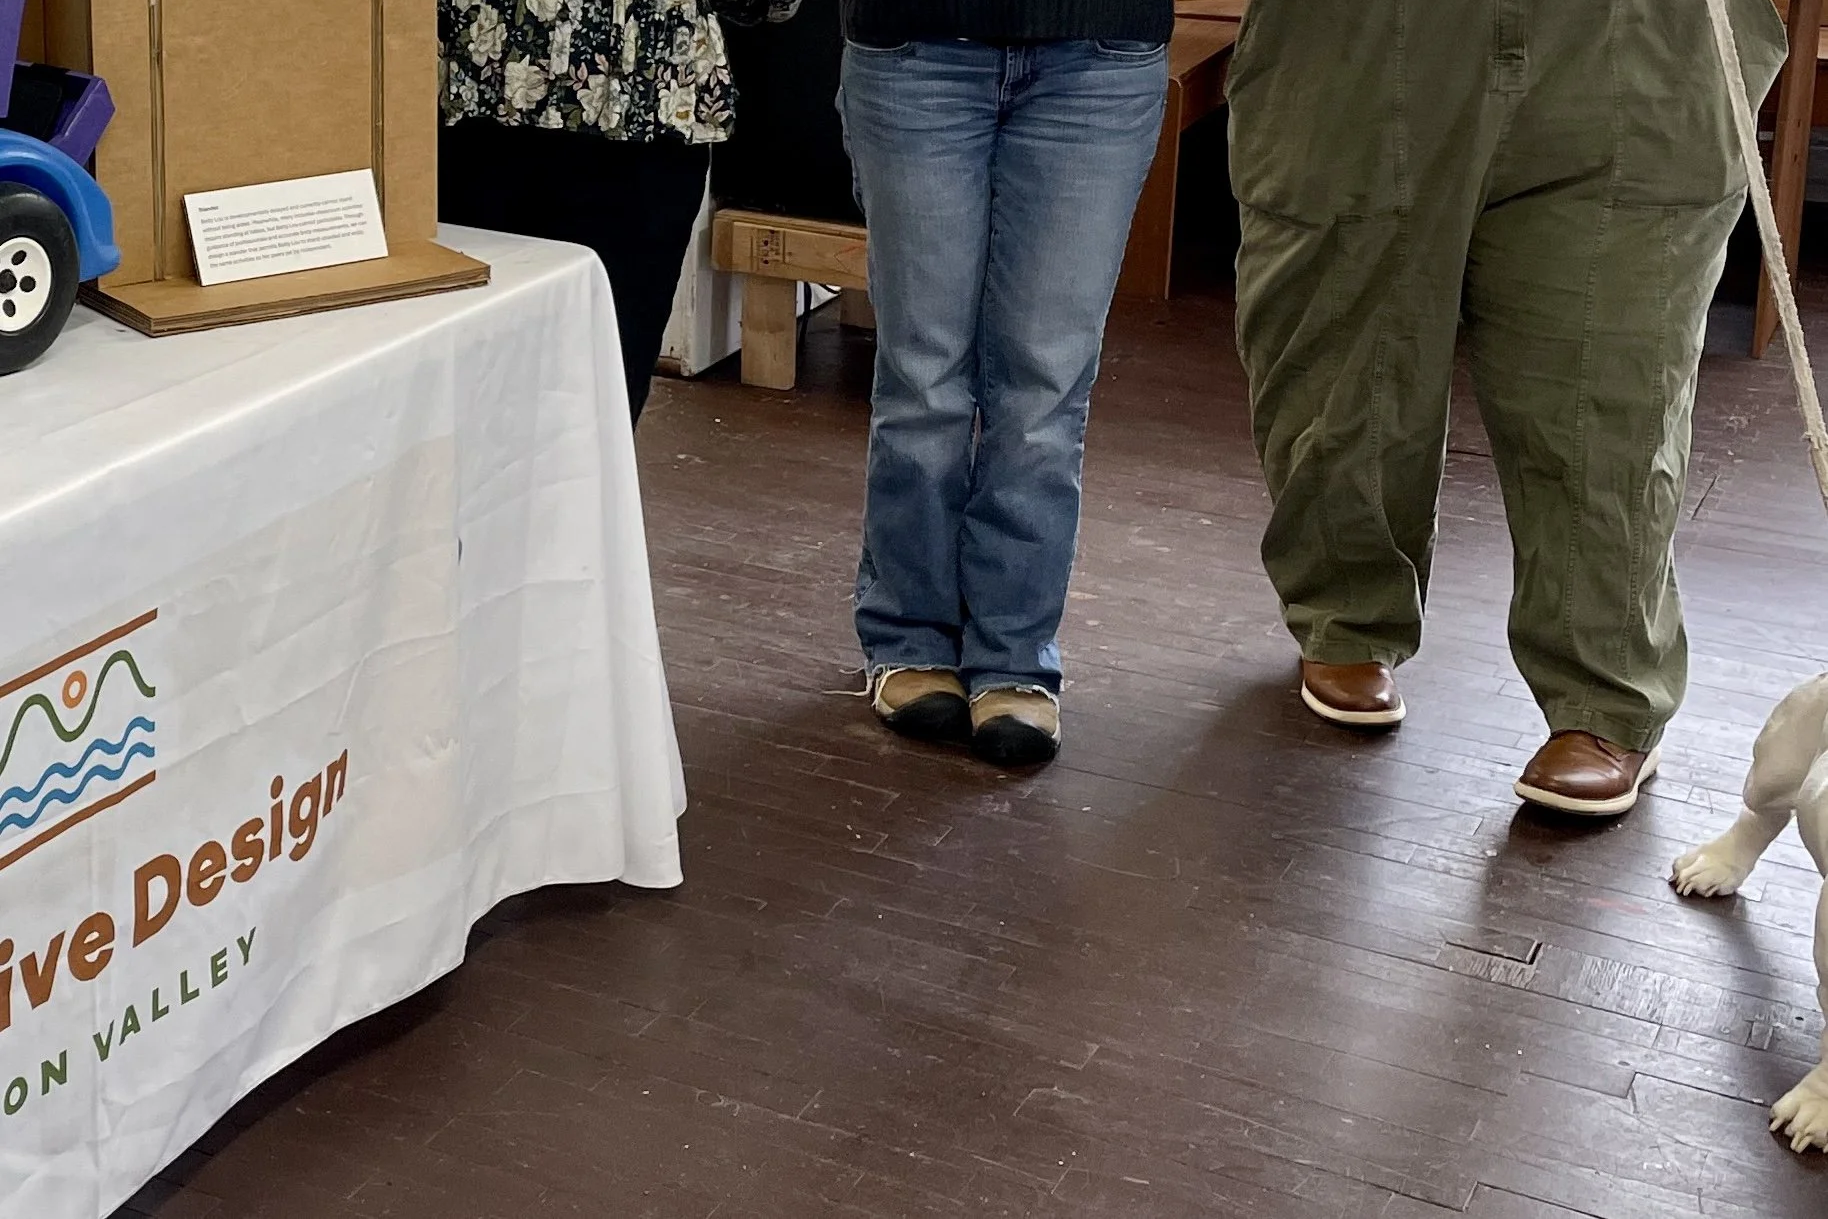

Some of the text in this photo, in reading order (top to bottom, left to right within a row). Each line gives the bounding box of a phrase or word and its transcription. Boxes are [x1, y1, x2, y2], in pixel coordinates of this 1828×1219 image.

[132, 748, 348, 948] Design
[3, 926, 256, 1116] ON VALLEY
